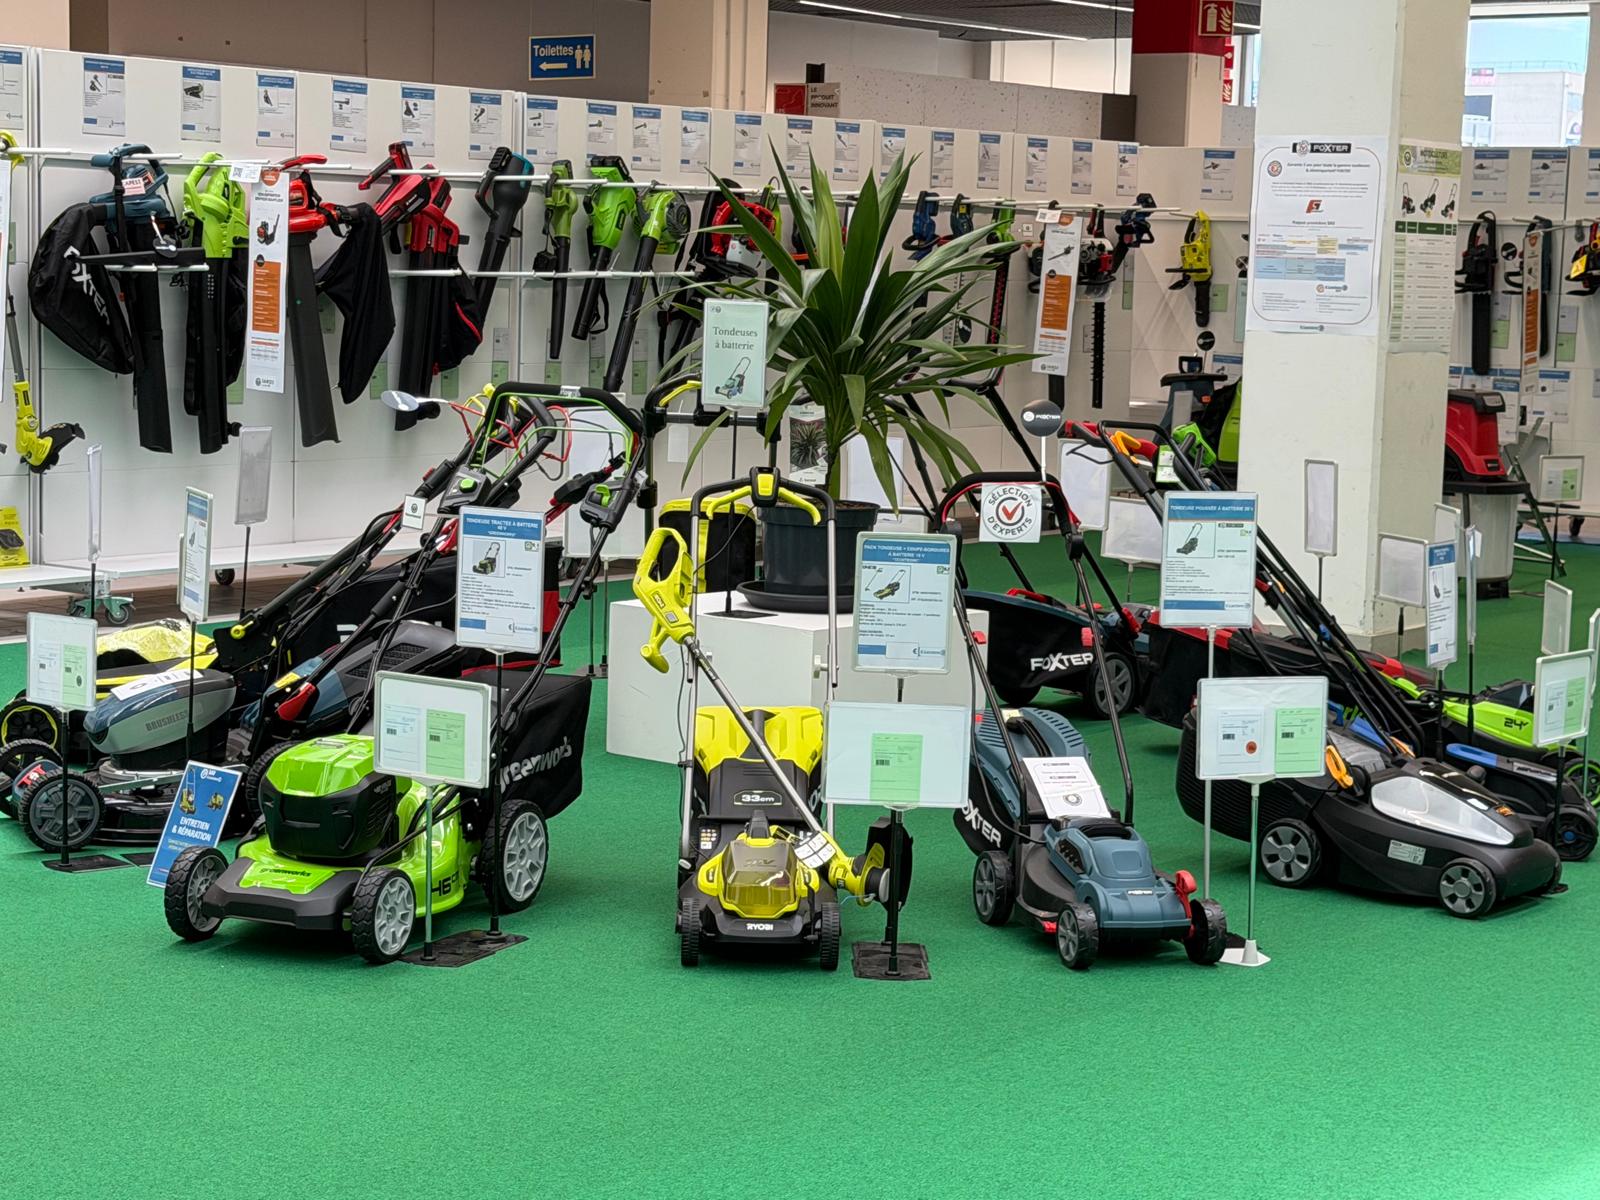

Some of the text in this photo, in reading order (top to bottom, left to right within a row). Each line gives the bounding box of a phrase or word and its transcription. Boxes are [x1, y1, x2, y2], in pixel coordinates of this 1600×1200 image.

[532, 44, 574, 57] Toilettes
[1312, 143, 1349, 153] FOXTER
[712, 326, 758, 337] Tondeuses
[714, 340, 754, 350] à batterie
[988, 487, 1033, 508] SÉLECTION
[516, 521, 539, 529] BATTERIE
[987, 515, 1033, 536] D'EXPERTS
[1030, 652, 1094, 671] FOXTER
[179, 816, 211, 831] ENTRETIEN
[177, 826, 213, 842] RÉPARATION
[746, 923, 774, 931] RYOBI
